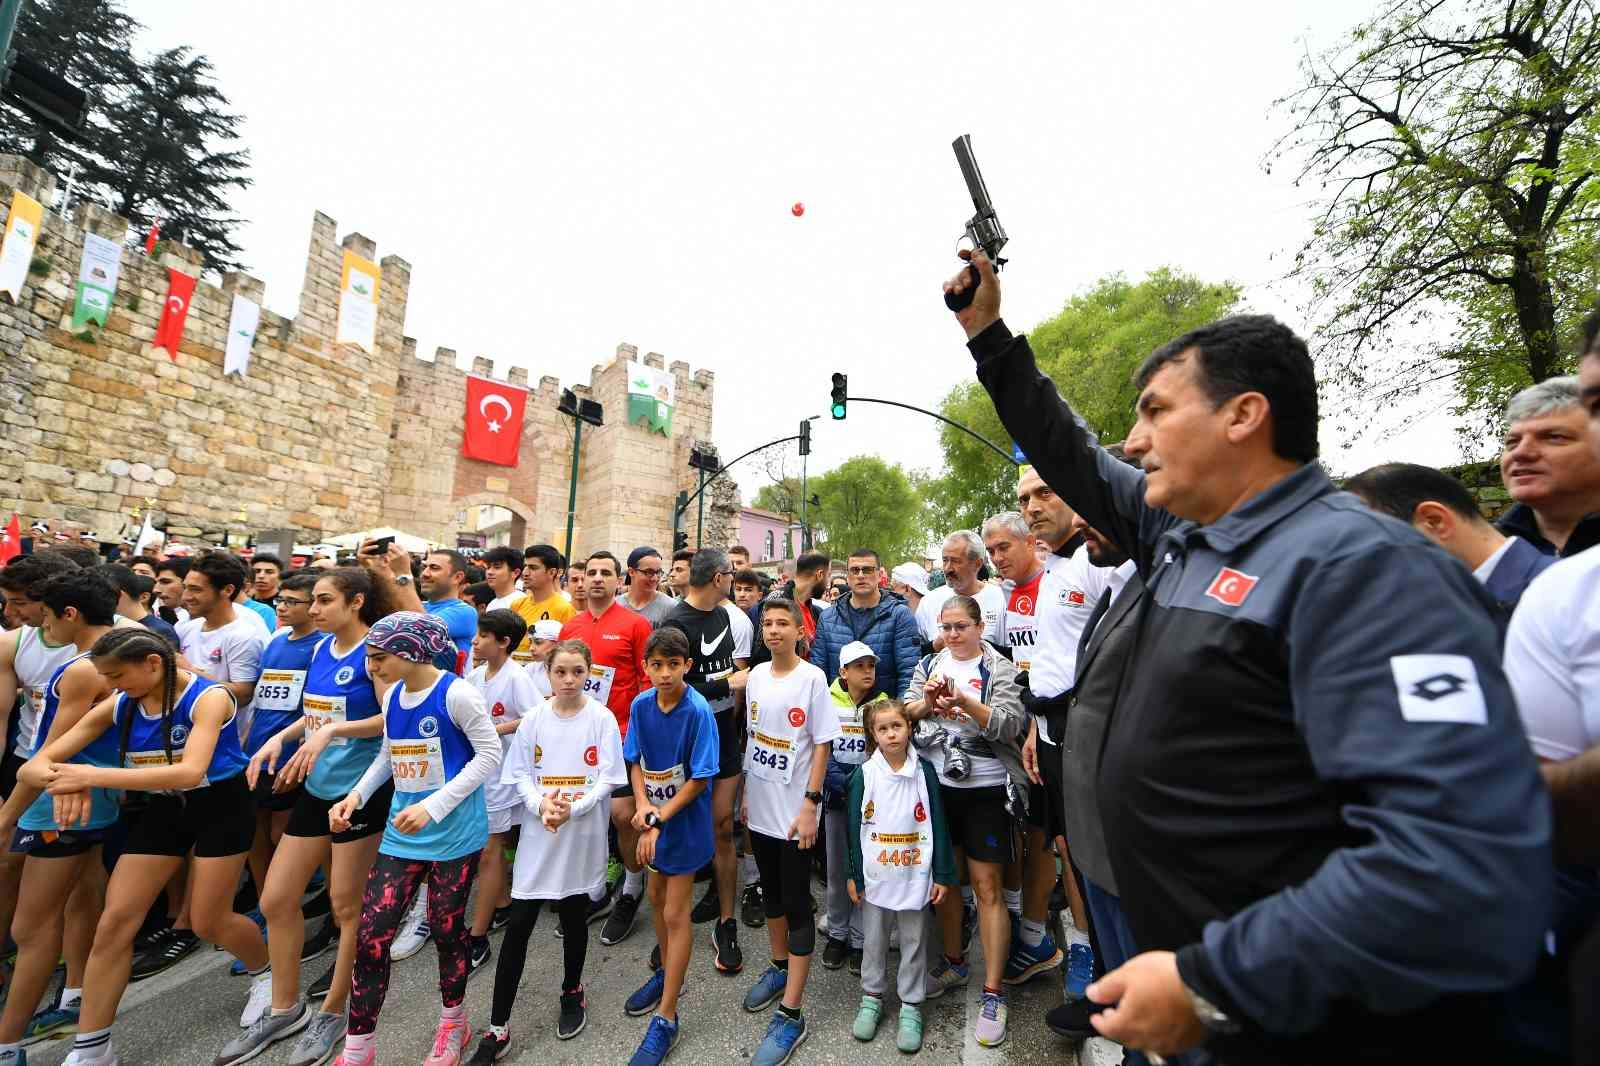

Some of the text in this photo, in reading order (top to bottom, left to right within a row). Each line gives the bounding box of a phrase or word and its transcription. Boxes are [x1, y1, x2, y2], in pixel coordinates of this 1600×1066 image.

[259, 685, 290, 699] 2653
[583, 679, 601, 692] 84
[838, 738, 866, 752] 249
[753, 746, 788, 770] 2643
[645, 783, 677, 800] 640
[876, 847, 922, 867] 4462
